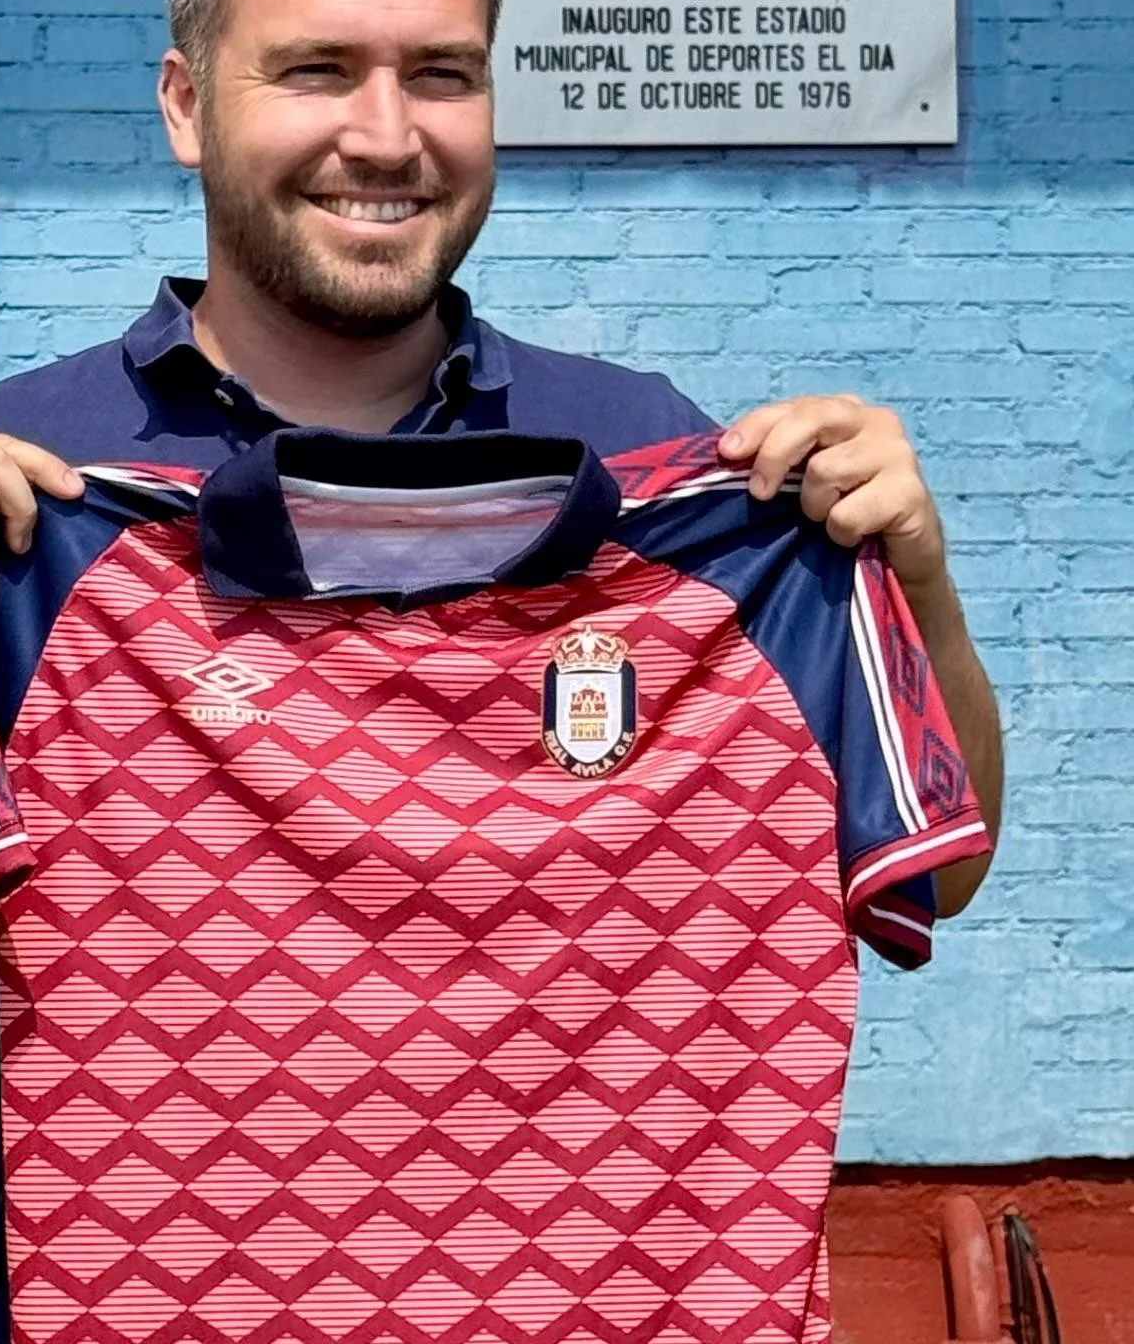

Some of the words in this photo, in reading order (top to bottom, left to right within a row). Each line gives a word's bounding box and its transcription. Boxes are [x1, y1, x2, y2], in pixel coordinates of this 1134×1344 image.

[561, 6, 671, 35] INAUGURO
[684, 6, 742, 35] ESTE
[755, 6, 846, 35] ESTADIO
[514, 44, 632, 73] MUNICIPAL
[645, 44, 675, 73] DE
[688, 44, 805, 73] DEPORTES
[817, 43, 846, 72] EL
[859, 43, 895, 72] DIA
[560, 82, 585, 111] 12
[597, 82, 627, 110] DE
[640, 81, 741, 110] OCTUBRE
[755, 81, 784, 109] DE
[798, 81, 852, 109] 1976
[189, 703, 273, 725] umbro
